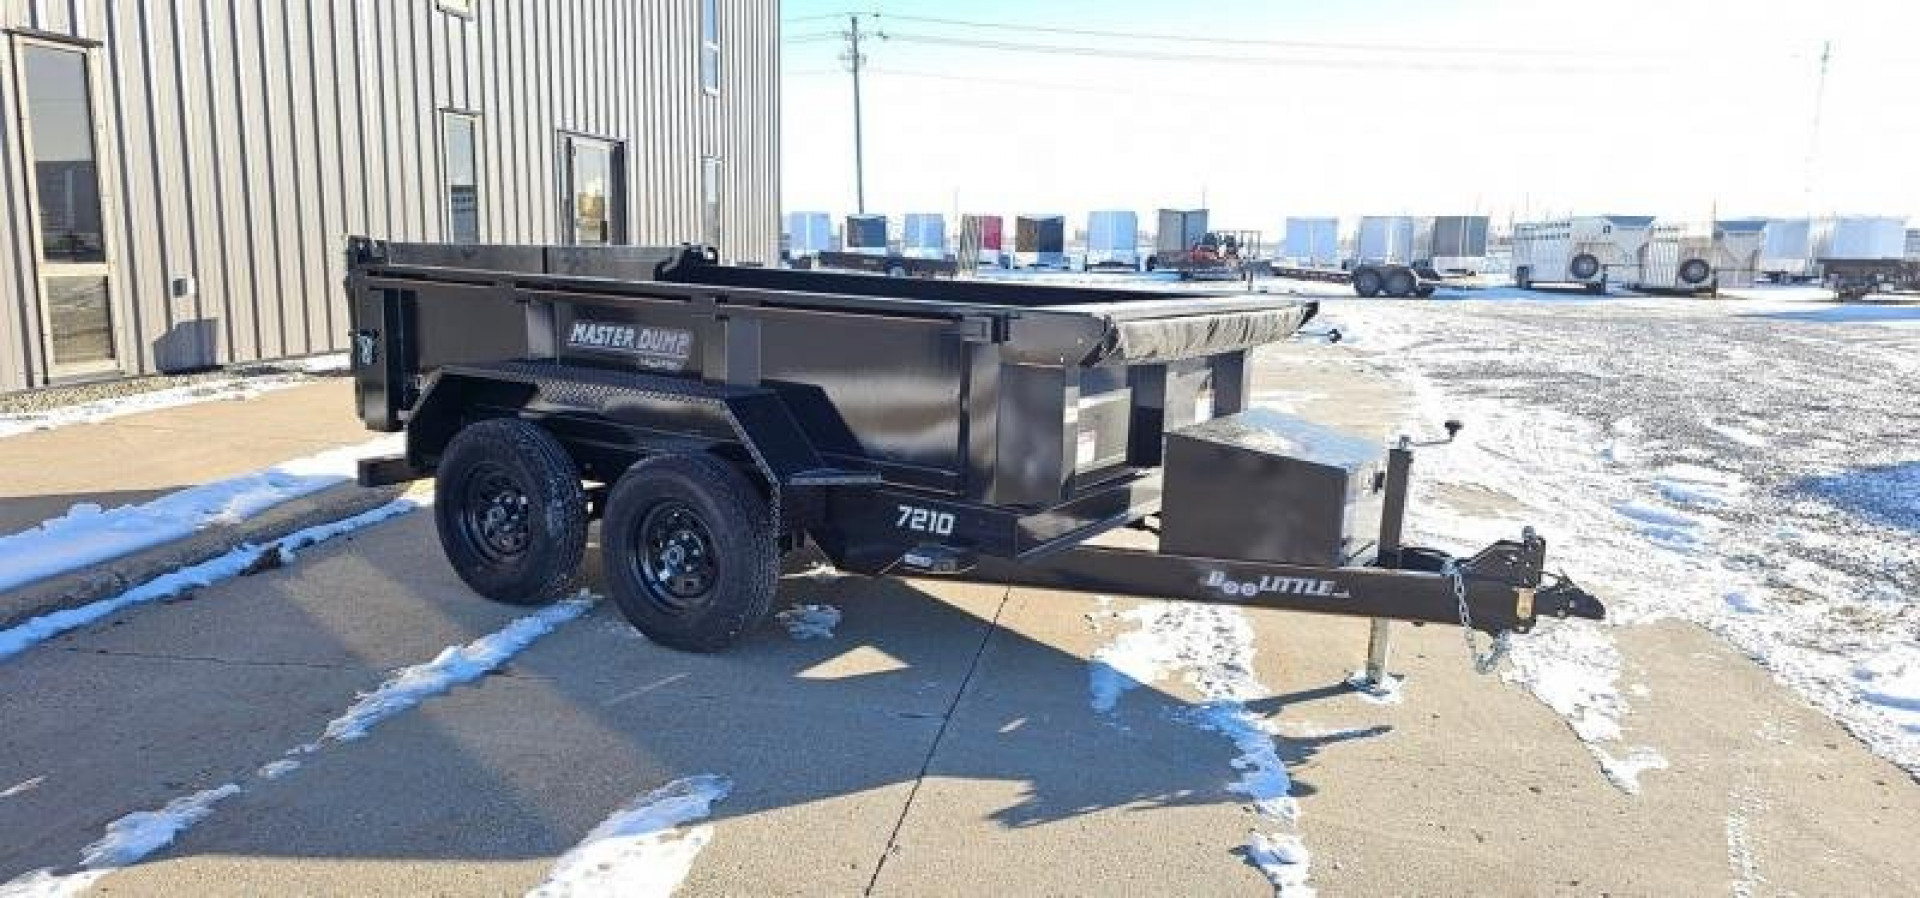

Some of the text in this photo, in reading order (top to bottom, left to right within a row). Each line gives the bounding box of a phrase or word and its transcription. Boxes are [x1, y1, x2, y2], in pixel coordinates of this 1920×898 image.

[570, 323, 690, 355] MASTER DUMP
[896, 505, 955, 534] 7210
